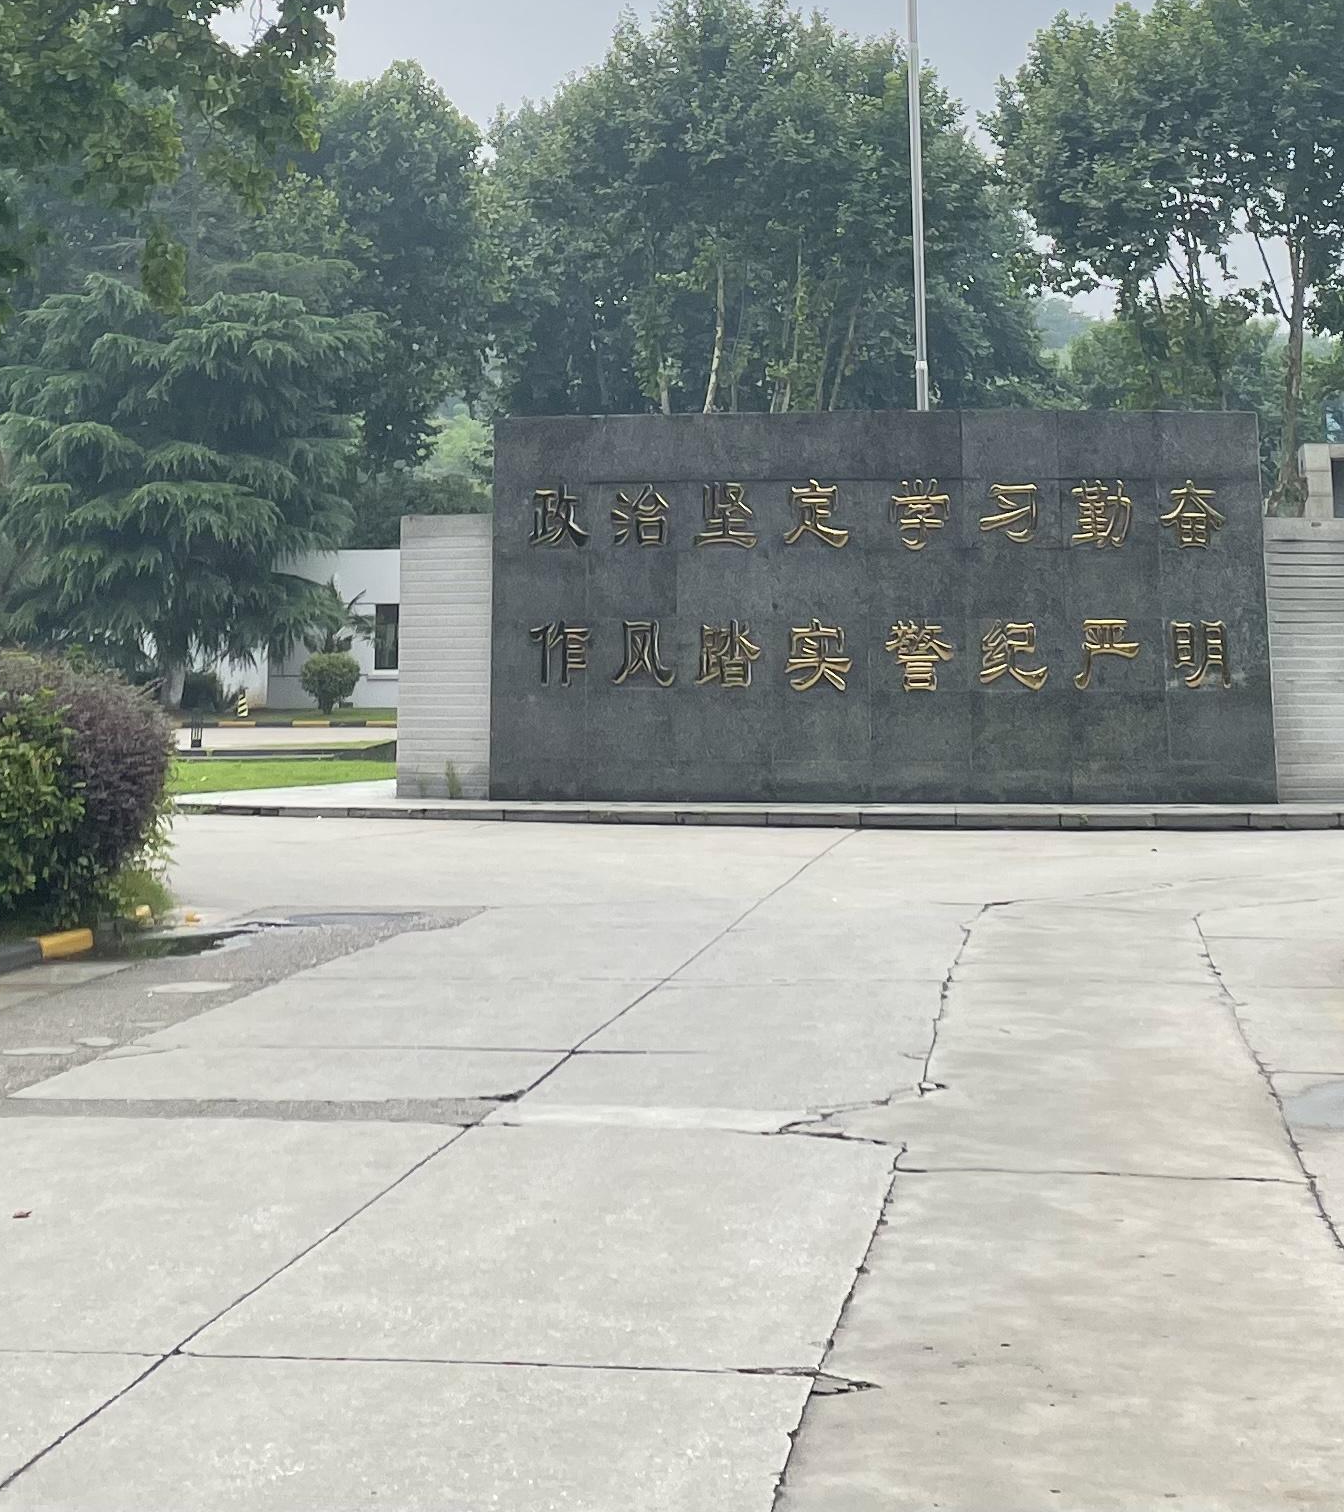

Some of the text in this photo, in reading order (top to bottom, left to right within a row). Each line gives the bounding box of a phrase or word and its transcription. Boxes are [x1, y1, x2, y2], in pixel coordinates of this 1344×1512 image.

[530, 478, 1227, 549] 政治坚定学习勤奋
[529, 618, 1231, 691] 作风踏实警纪严明
